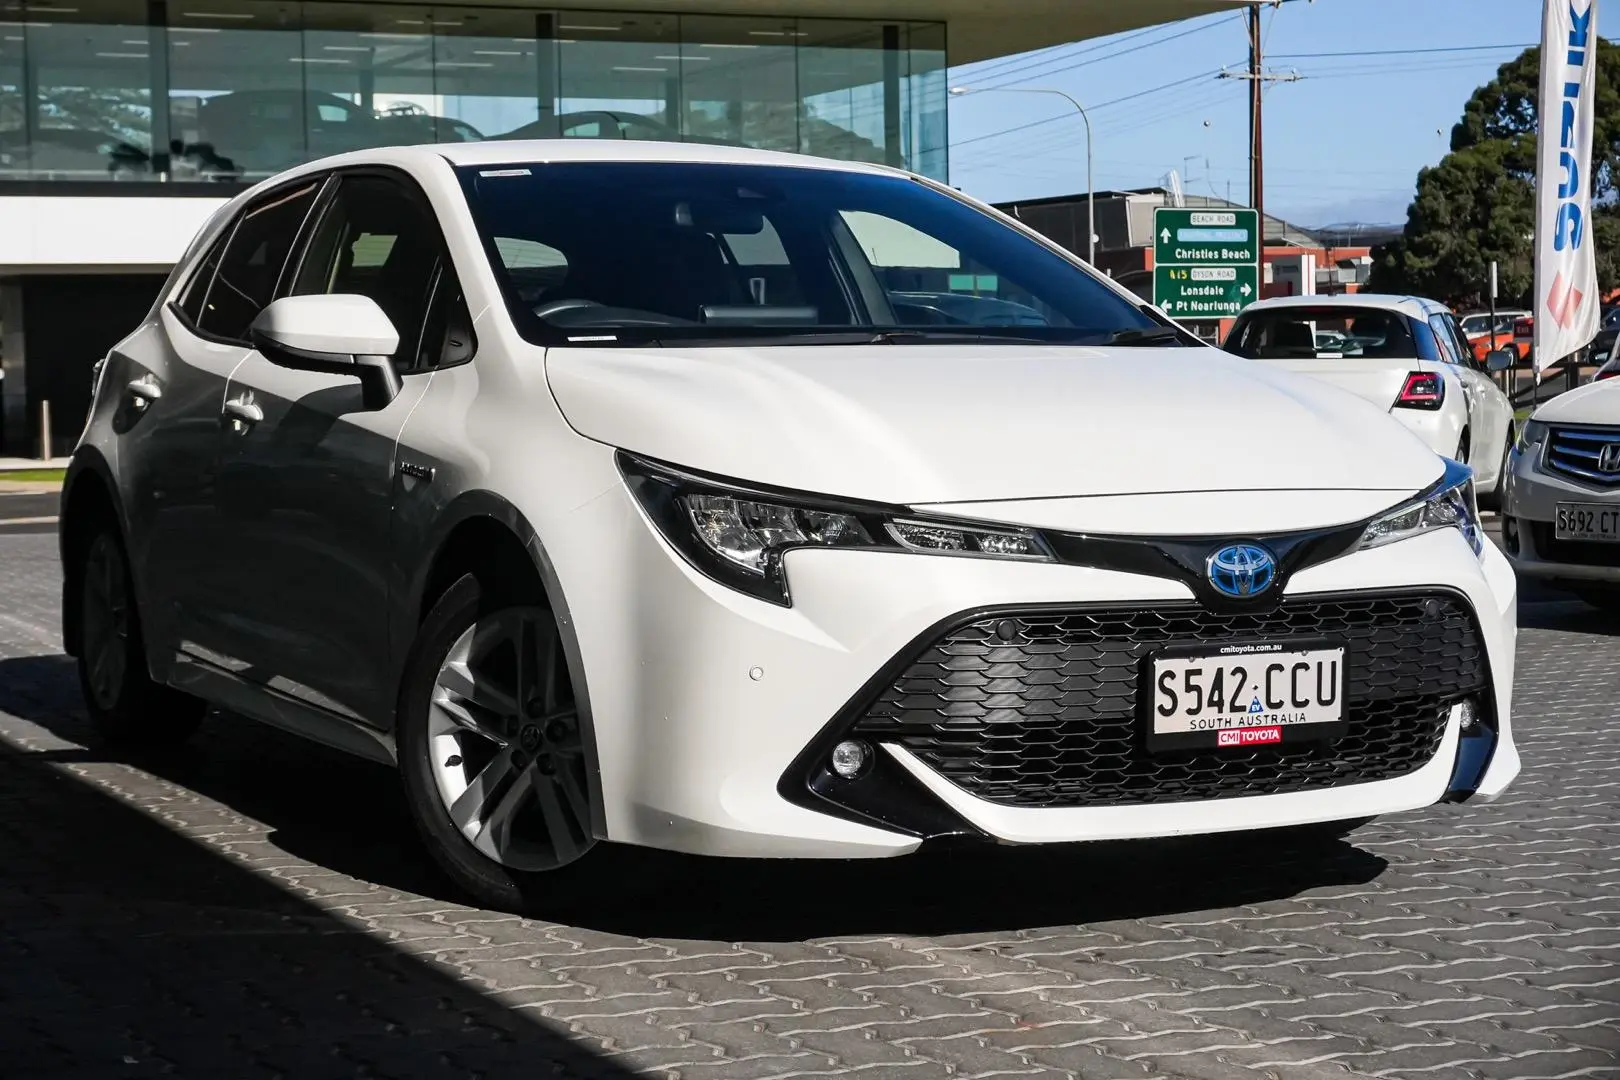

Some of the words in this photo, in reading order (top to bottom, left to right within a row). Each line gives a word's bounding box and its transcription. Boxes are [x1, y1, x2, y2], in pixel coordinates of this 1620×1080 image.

[1192, 215, 1214, 223] BEACH
[1217, 215, 1234, 223] ROAD
[1175, 248, 1219, 259] Christies
[1221, 248, 1251, 259] Beach
[1217, 270, 1235, 278] ROAD
[1180, 285, 1224, 296] Lonsdale
[1176, 301, 1188, 311] Pt
[1190, 301, 1241, 313] Noarlunga
[1558, 510, 1594, 532] S692
[1220, 644, 1283, 655] cmitoyota.com.au
[1190, 717, 1232, 730] SOUTH
[1238, 712, 1307, 727] AUSTRALIA
[1220, 732, 1239, 744] CMI
[1241, 730, 1280, 742] TOYOTA
